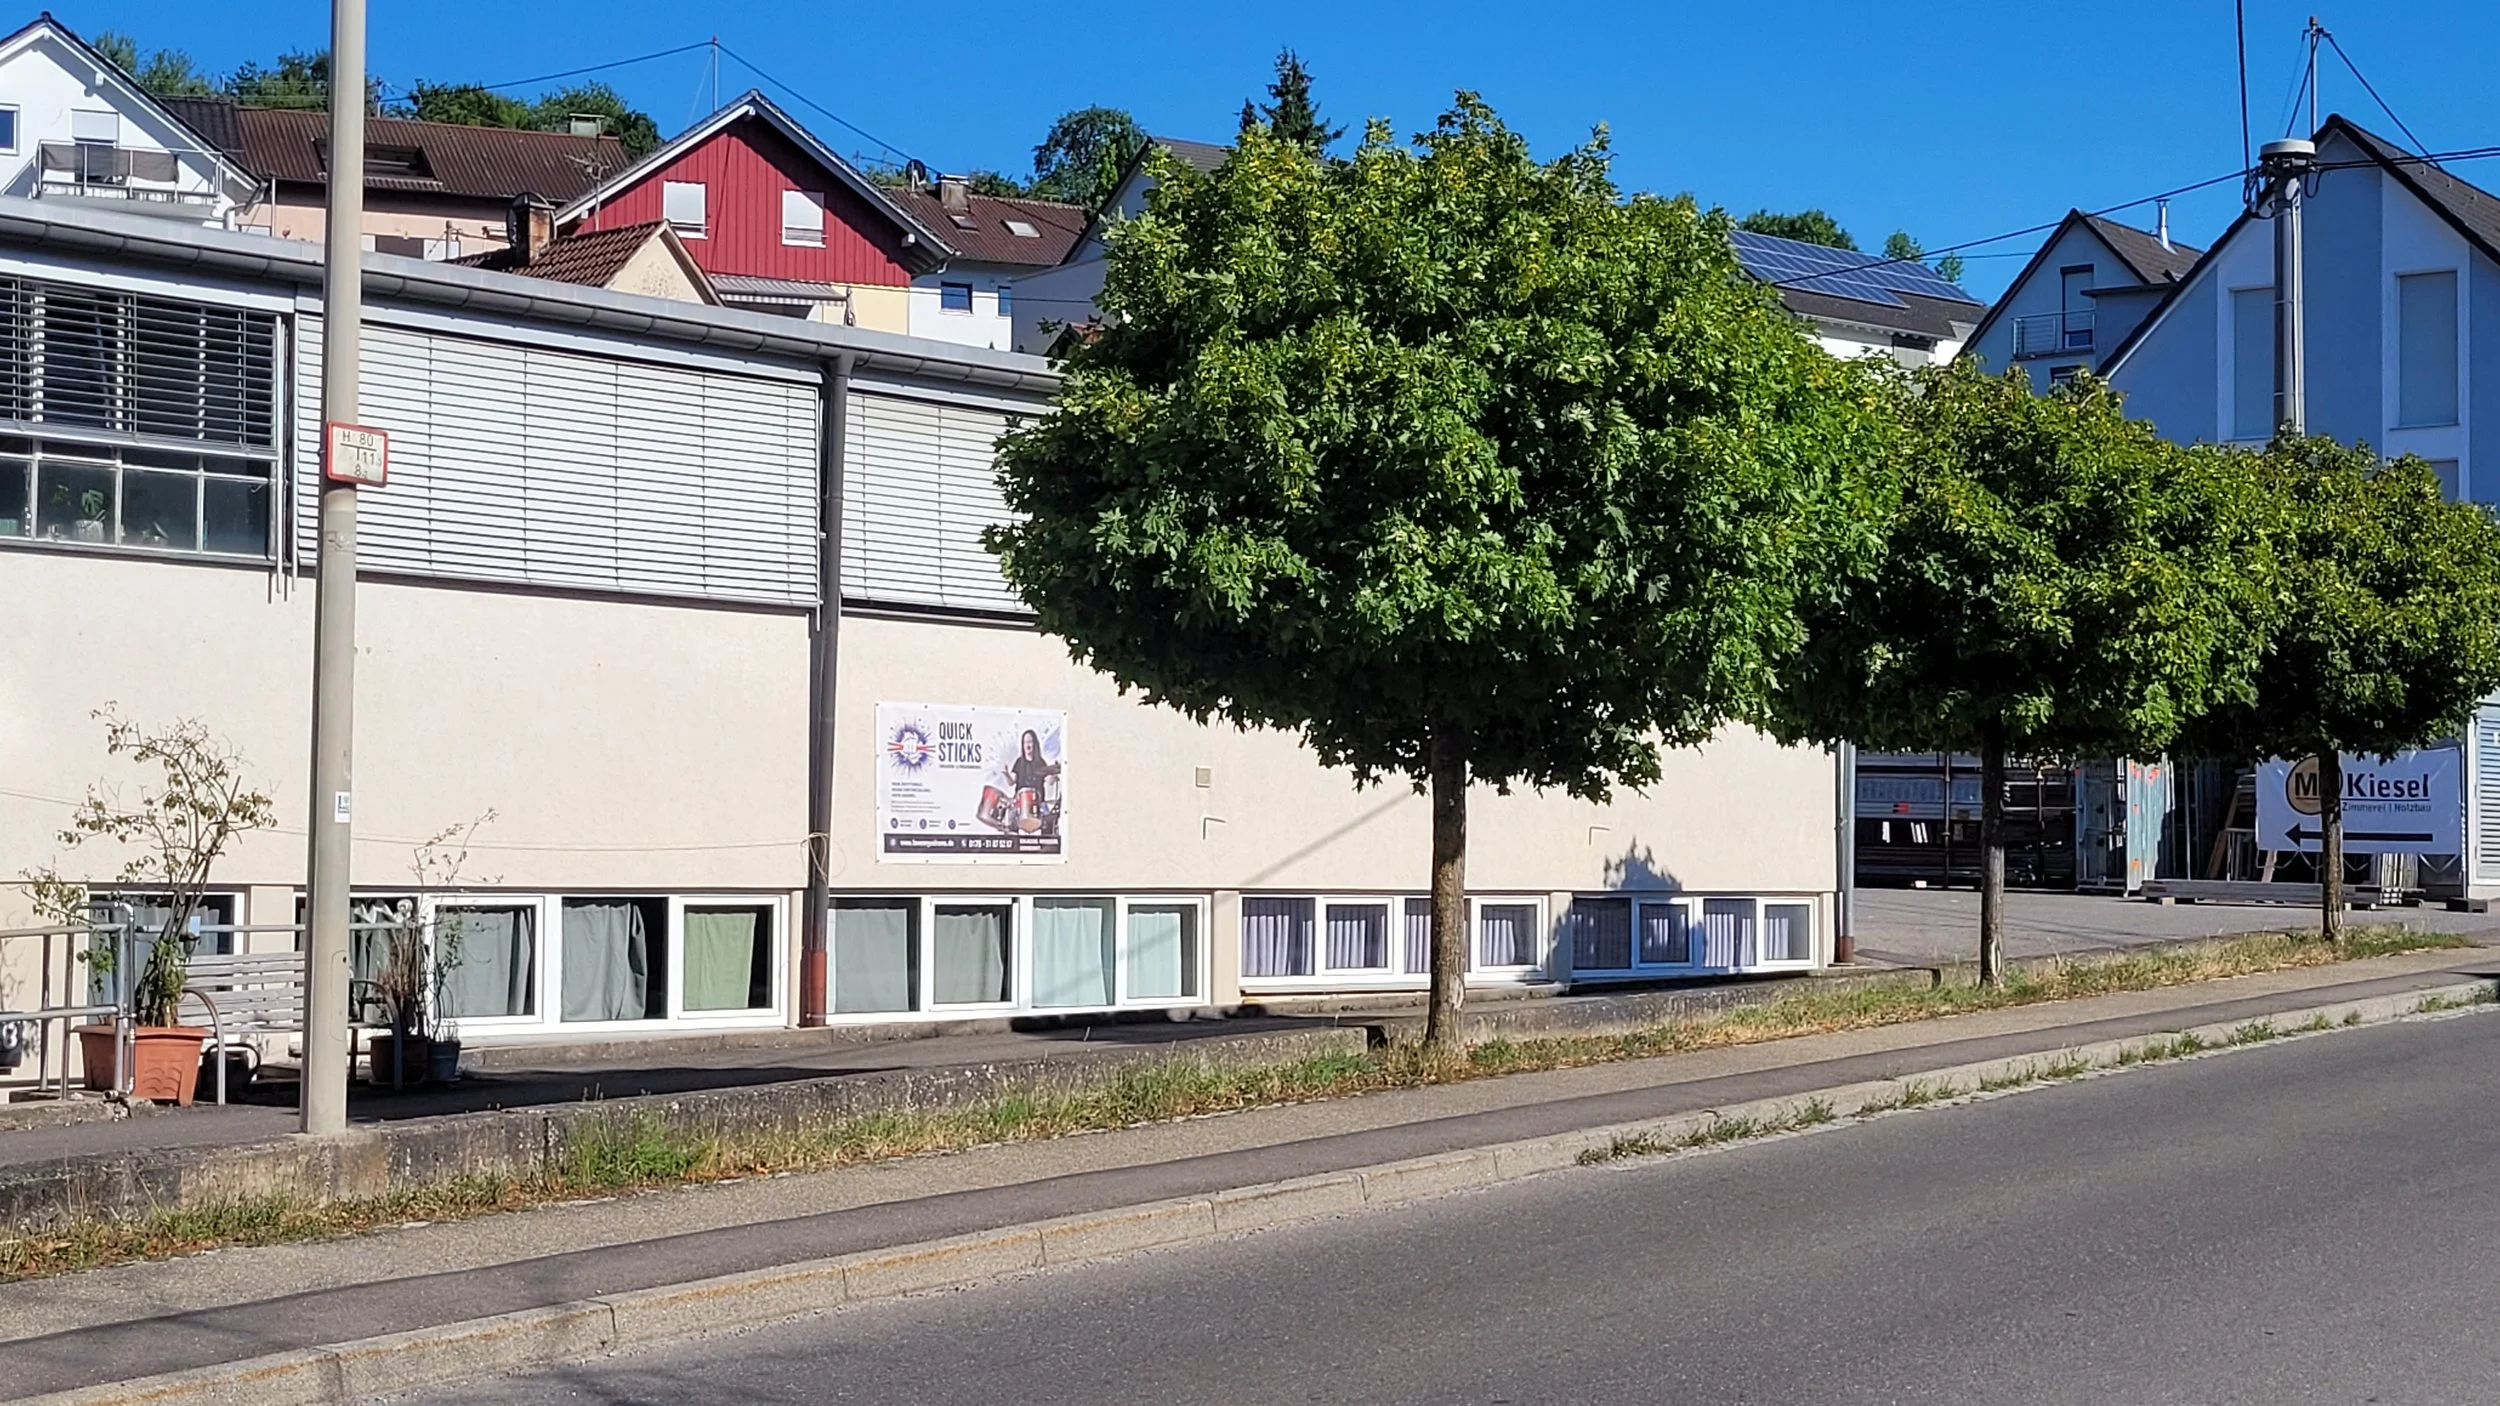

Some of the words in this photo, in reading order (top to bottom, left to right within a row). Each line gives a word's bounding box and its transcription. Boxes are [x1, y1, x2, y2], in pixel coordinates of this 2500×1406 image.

[343, 431, 350, 442] H
[360, 433, 373, 447] 80
[939, 722, 973, 741] QUICK
[938, 742, 982, 763] STICKS
[2347, 773, 2429, 798] Kiesel
[2342, 802, 2386, 812] Zimmerei
[2394, 803, 2432, 813] Holzbau
